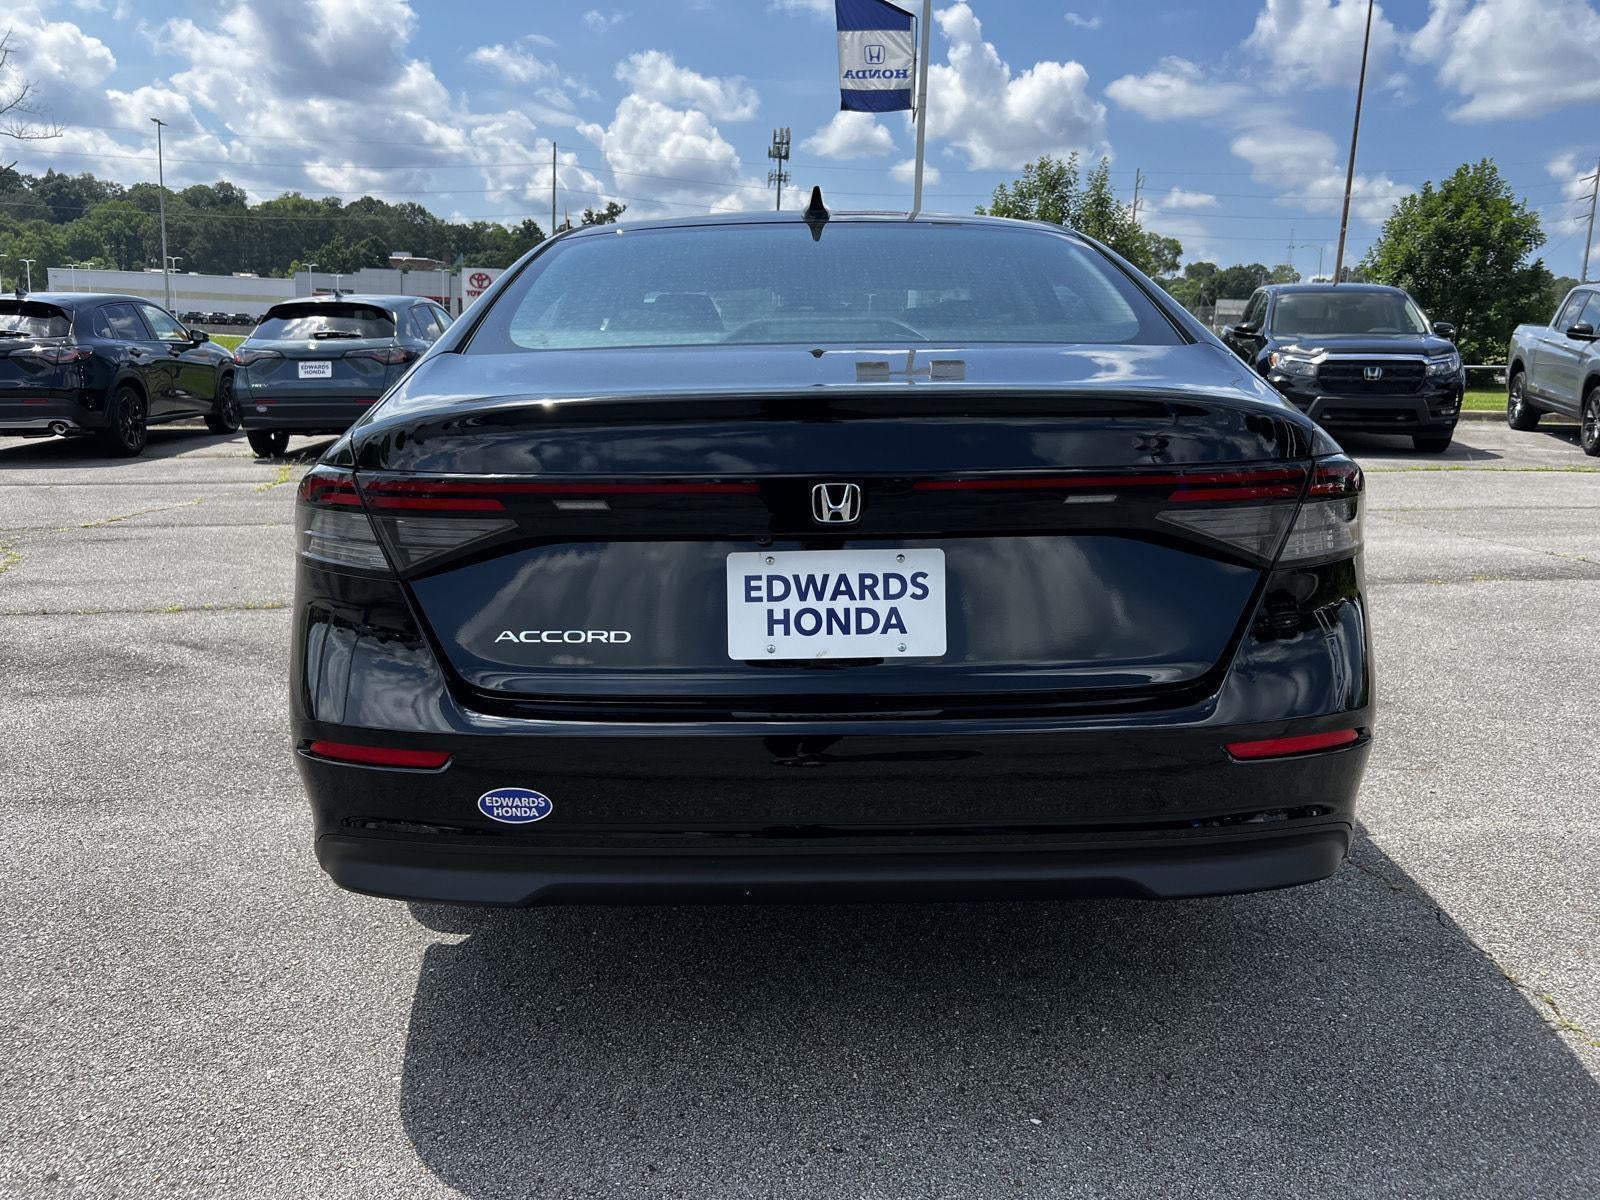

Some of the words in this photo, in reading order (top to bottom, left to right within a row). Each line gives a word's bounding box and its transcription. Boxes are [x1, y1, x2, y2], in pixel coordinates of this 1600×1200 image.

[744, 571, 930, 602] EDWARDS
[766, 606, 908, 636] HONDA
[494, 630, 632, 643] ACCORD
[485, 797, 545, 807] EDWARDS
[493, 807, 539, 817] HONDA
